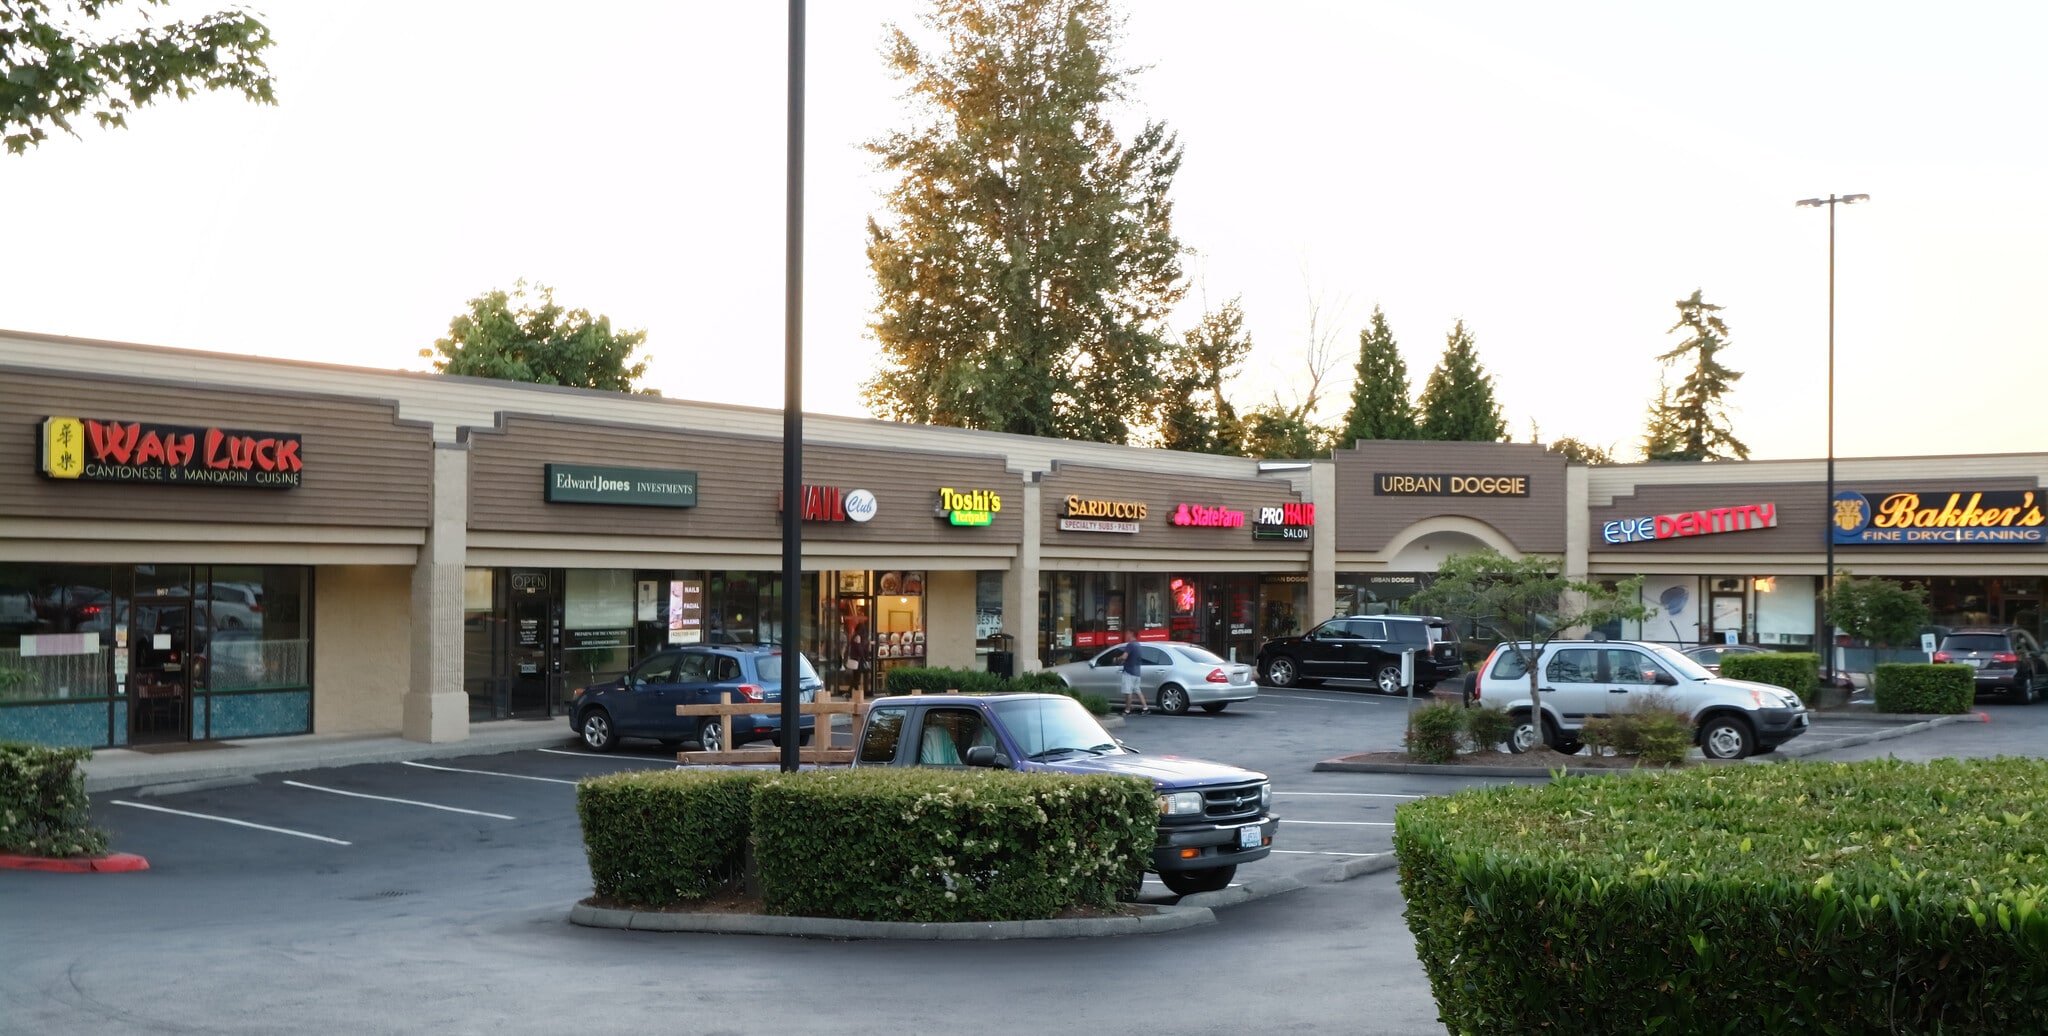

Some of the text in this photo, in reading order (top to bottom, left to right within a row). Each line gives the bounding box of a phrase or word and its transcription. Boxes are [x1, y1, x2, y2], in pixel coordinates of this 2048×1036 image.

[86, 419, 303, 472] WAH LUCK
[85, 463, 299, 485] CANTONESE & MANDARIN CUISINE
[637, 482, 693, 495] INVESTMENTS
[1381, 476, 1526, 495] URBAN DOGGIE
[847, 495, 874, 514] Club
[940, 487, 1001, 512] Toshi's
[1874, 491, 2046, 528] Bakker's
[1064, 520, 1097, 530] SPECIALTY
[1283, 528, 1309, 539] SALON
[1862, 529, 2042, 542] FINE DRYCLEANING
[514, 575, 545, 588] OPEN
